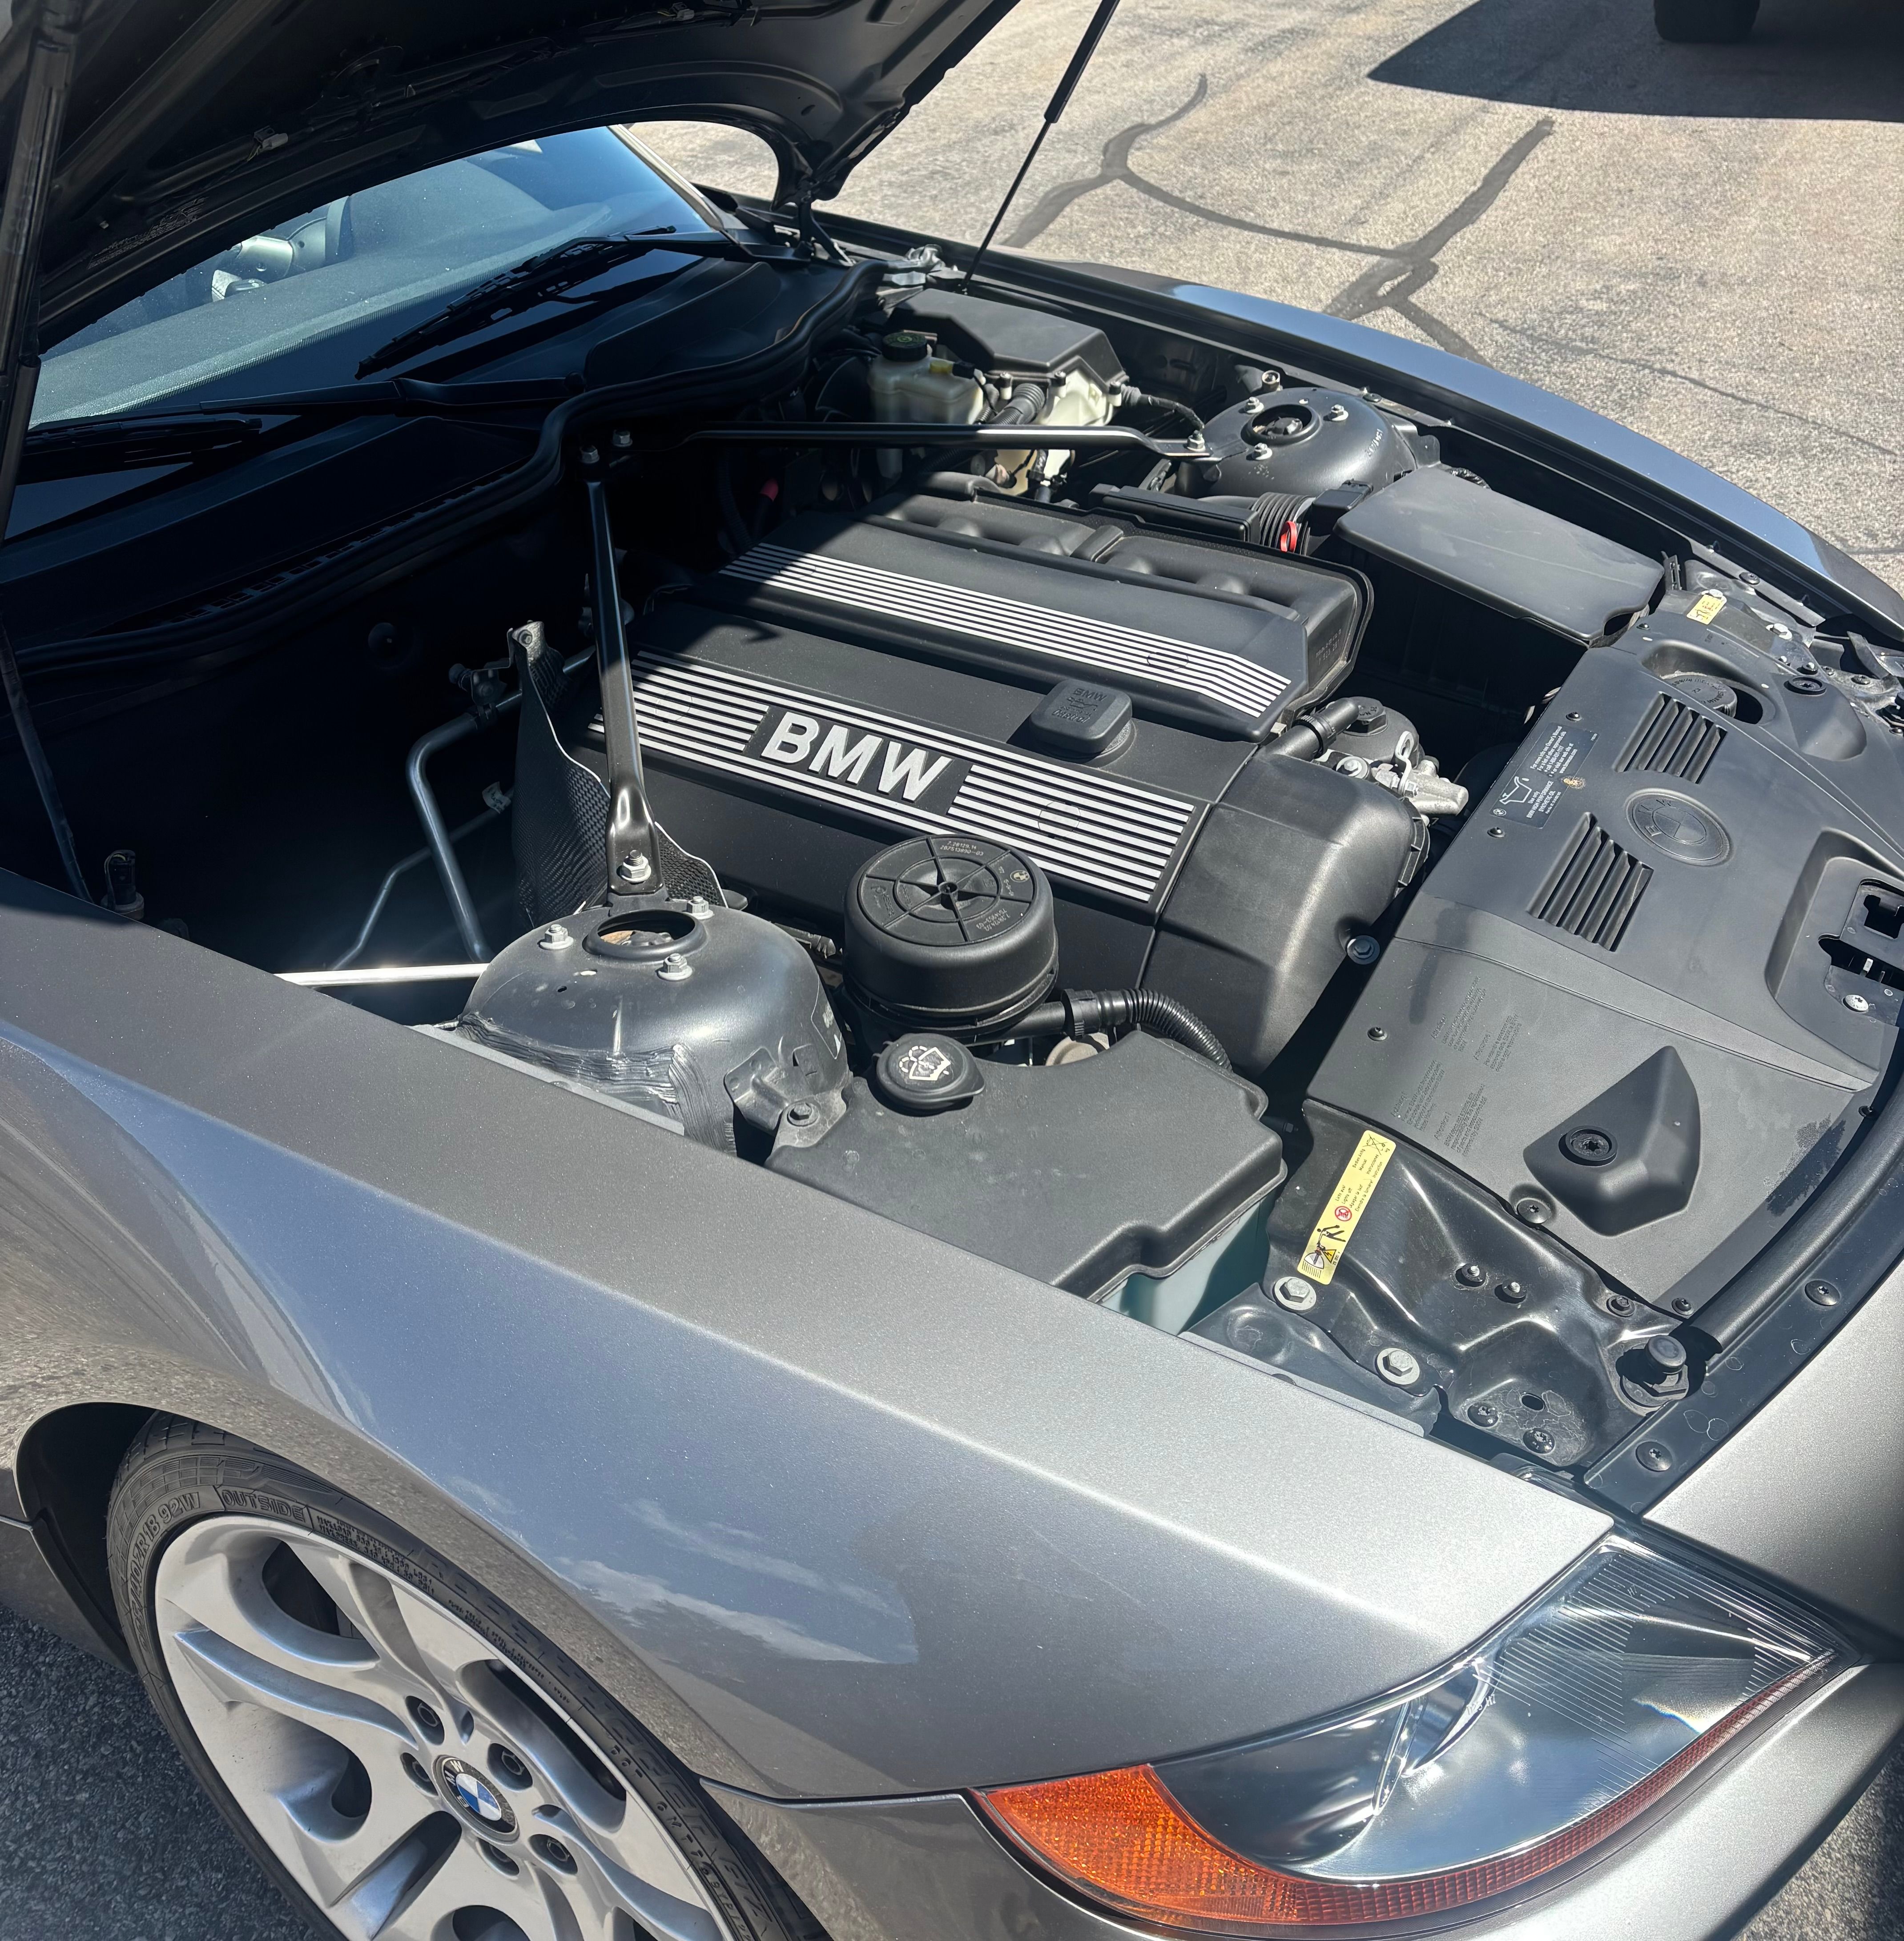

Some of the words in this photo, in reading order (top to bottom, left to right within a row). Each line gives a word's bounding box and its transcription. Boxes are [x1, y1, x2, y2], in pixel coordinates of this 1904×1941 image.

[1073, 688, 1107, 701] BMW
[761, 712, 953, 802] BMW
[157, 1491, 200, 1524] 92W
[222, 1490, 306, 1522] OUTSIDE
[444, 1760, 470, 1808] BMW
